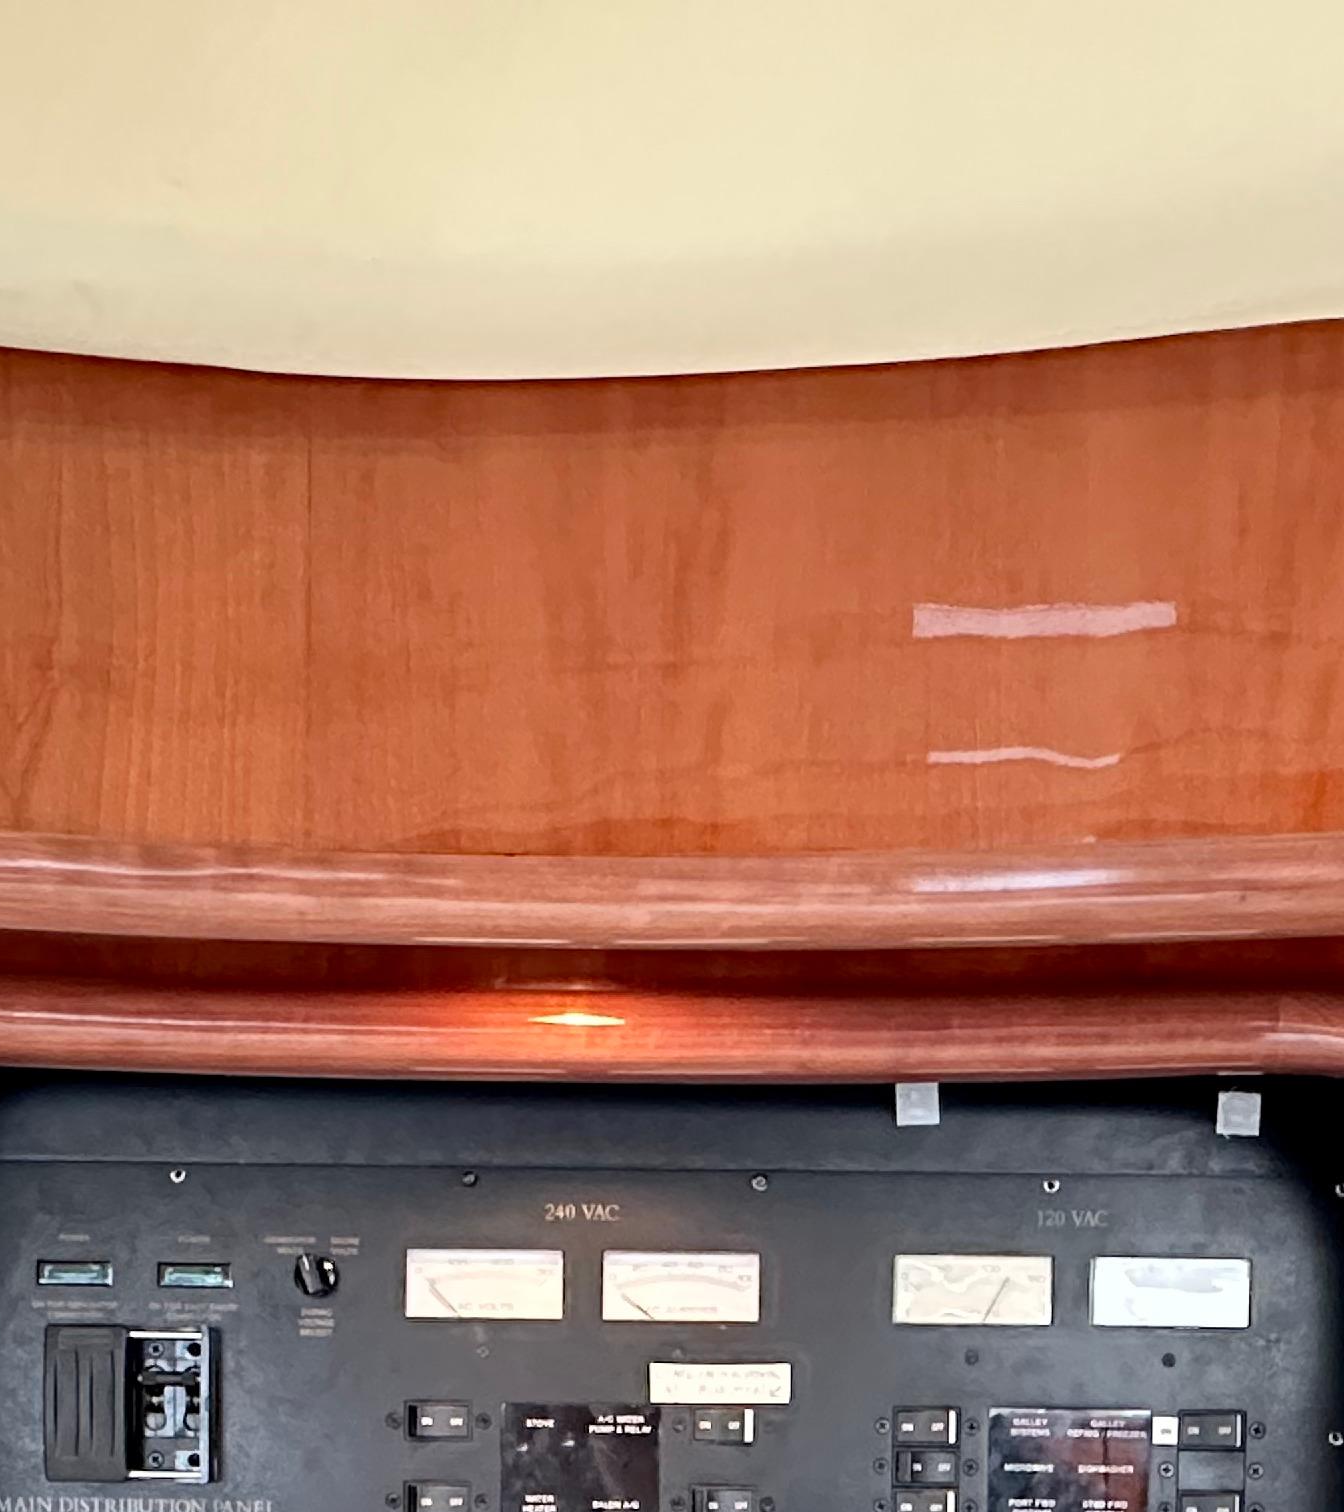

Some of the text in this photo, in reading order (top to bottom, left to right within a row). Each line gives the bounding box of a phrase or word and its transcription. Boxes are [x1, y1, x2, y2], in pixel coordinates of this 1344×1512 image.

[545, 1204, 620, 1222] 240 VAC
[1038, 1210, 1111, 1228] 120 VAC
